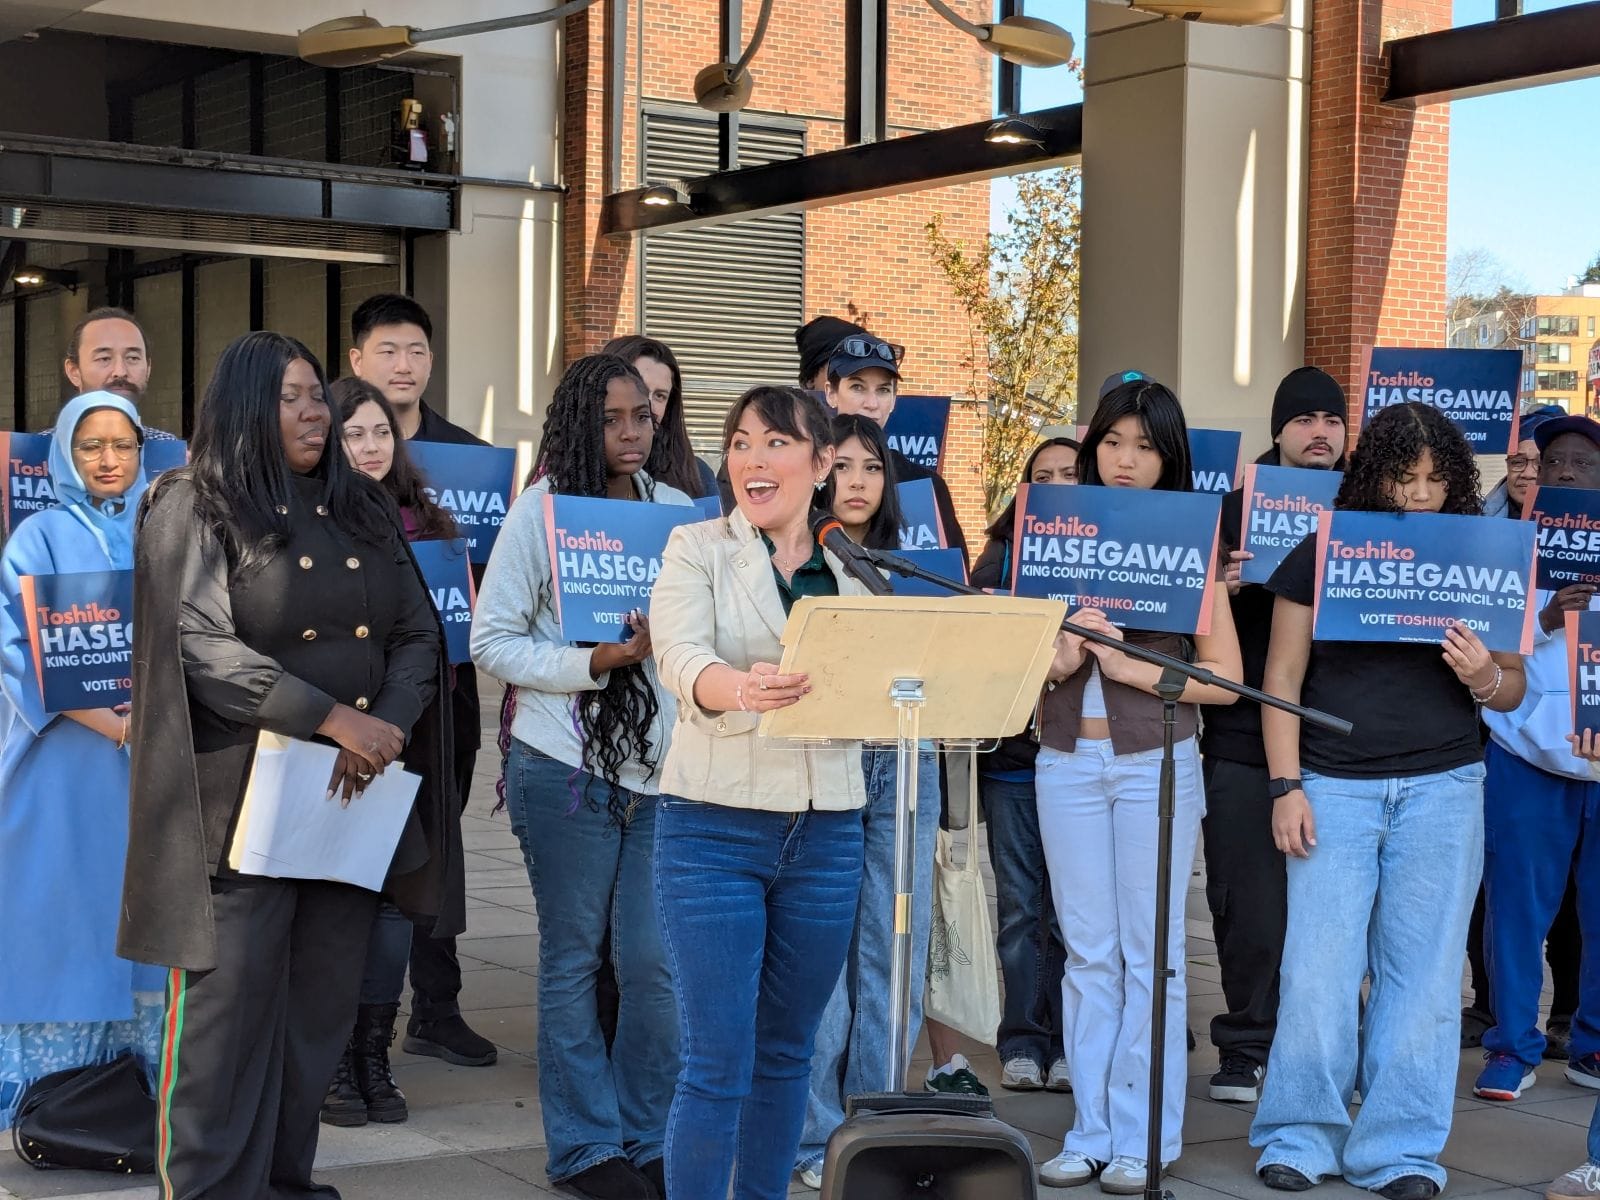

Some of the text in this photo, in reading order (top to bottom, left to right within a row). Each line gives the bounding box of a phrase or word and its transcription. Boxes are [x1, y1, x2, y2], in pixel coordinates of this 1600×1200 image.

[1370, 371, 1435, 387] Toshiko
[1367, 387, 1513, 411] HASEGAWA
[1443, 410, 1513, 421] COUNCIL D2
[926, 457, 938, 466] D2
[14, 499, 45, 511] KING
[1253, 492, 1324, 514] Toshiko
[1025, 515, 1099, 538] Toshiko
[556, 528, 624, 553] Toshiko
[1250, 535, 1280, 547] KING
[1329, 540, 1415, 561] Toshiko
[1022, 536, 1205, 574] HASEGAWA
[558, 551, 665, 583] HASEGA
[1022, 565, 1204, 589] KING COUNTY COUNCIL D2
[1327, 560, 1525, 596] HASEGAWA
[563, 581, 591, 594] KING
[592, 583, 637, 597] COUNTY
[1326, 586, 1525, 610] KING COUNTY COUNCIL D2
[37, 602, 120, 626] Toshiko
[455, 612, 471, 623] D2
[1359, 613, 1490, 633] VOTETOSHIKOCOM
[46, 650, 133, 668] KING COUNT
